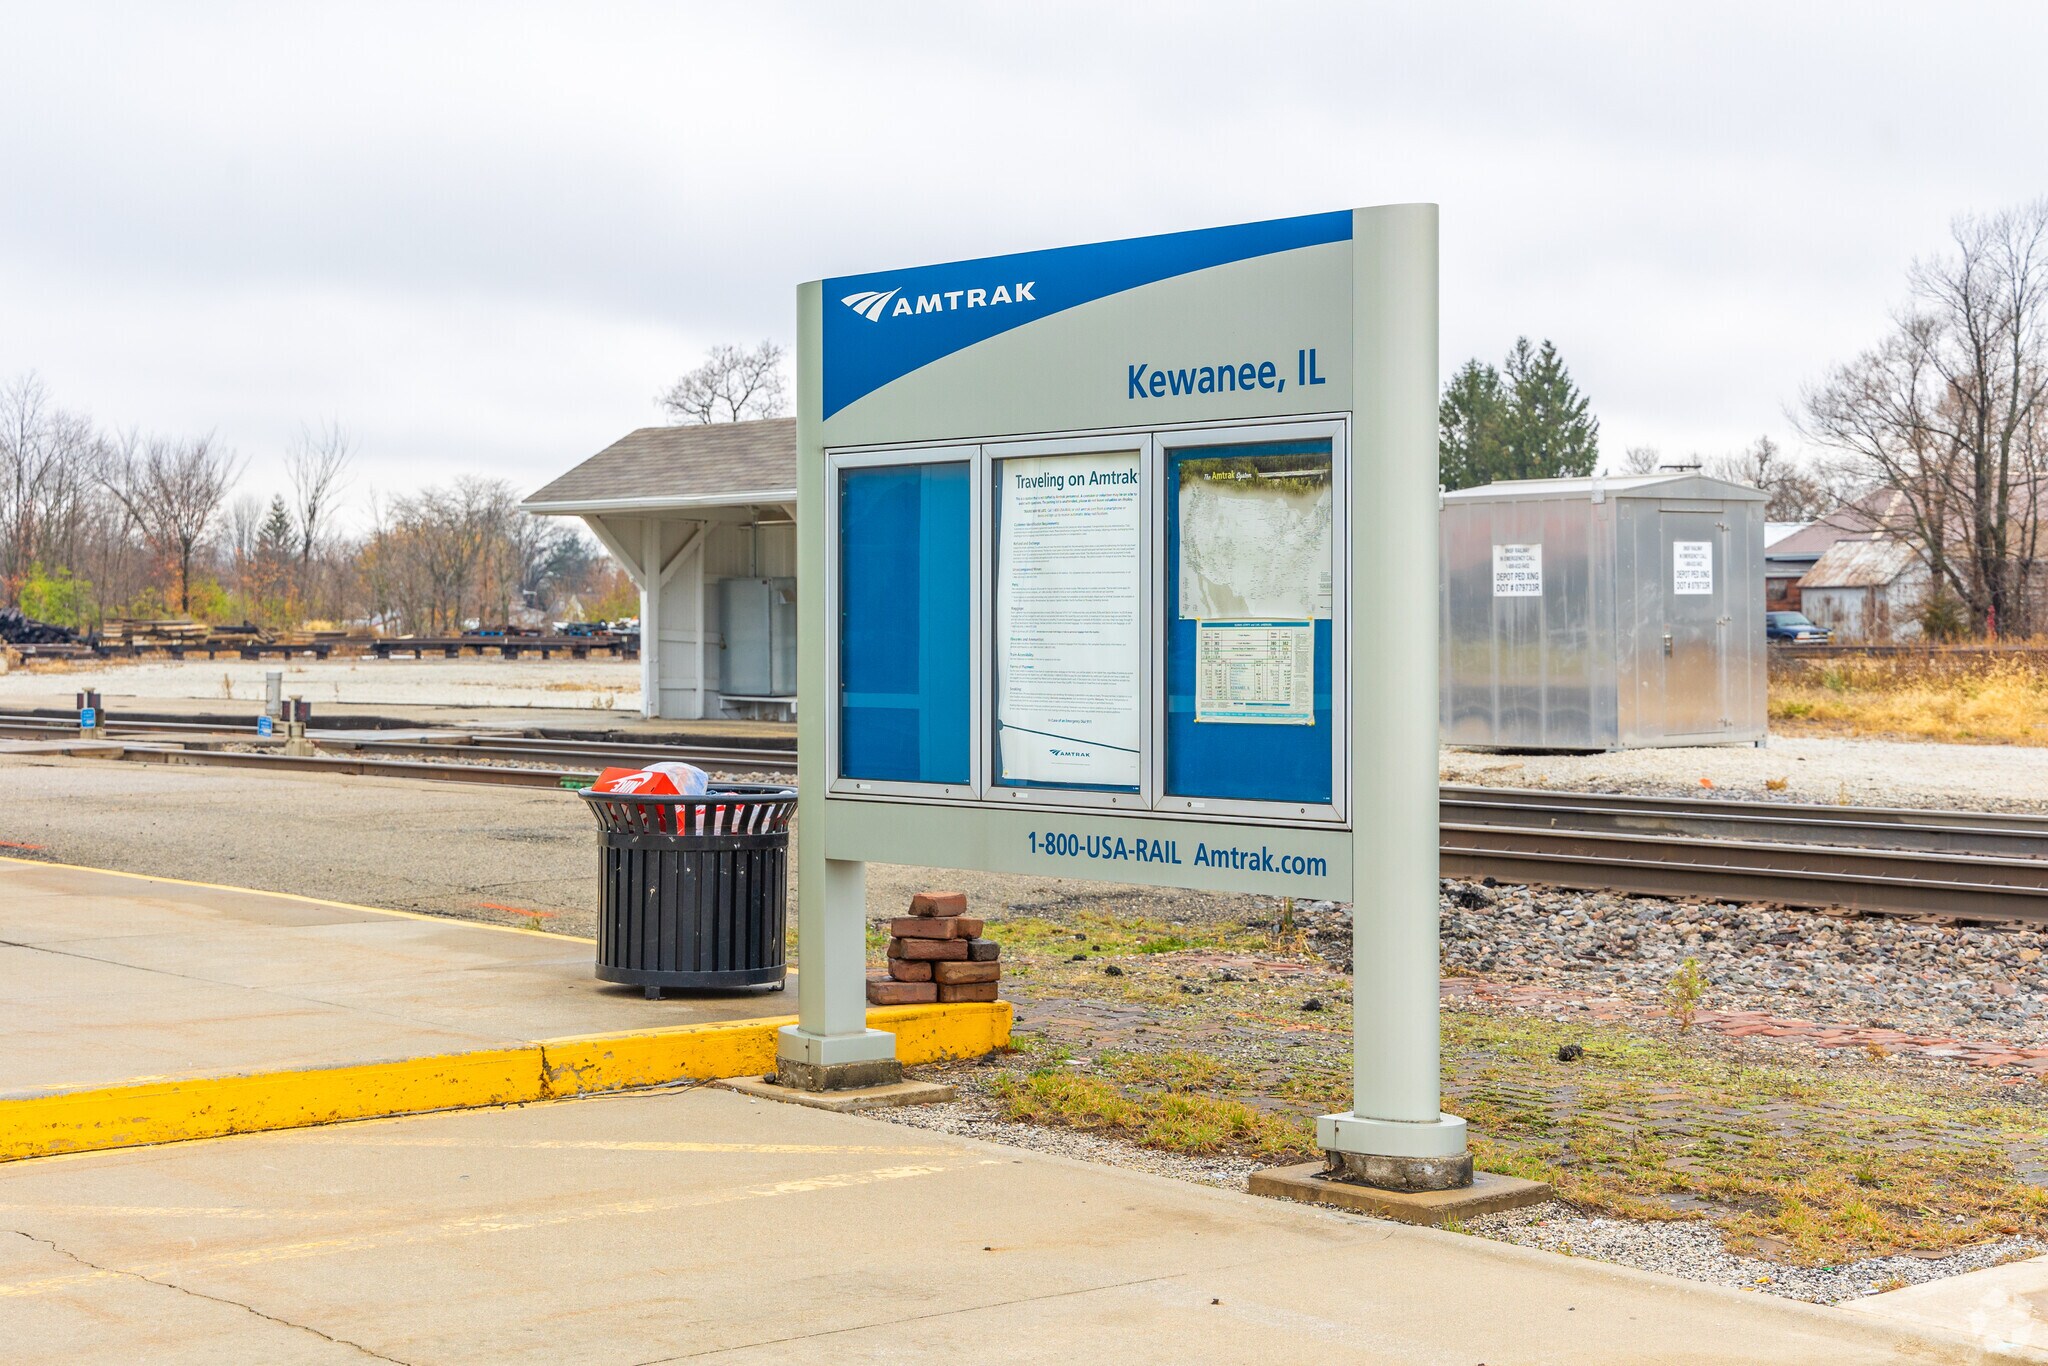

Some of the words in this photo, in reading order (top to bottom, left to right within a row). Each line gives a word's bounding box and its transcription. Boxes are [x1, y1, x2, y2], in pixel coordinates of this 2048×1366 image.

[892, 281, 1036, 317] AMTRAK
[1128, 361, 1286, 399] Kewanee,
[1298, 348, 1326, 386] IL
[1015, 472, 1064, 491] Traveling
[1068, 474, 1085, 486] on
[1089, 468, 1138, 485] Amtrak
[1211, 470, 1235, 480] Amtrak
[1496, 572, 1513, 581] DEPOT
[1515, 572, 1525, 580] PED
[1526, 572, 1539, 580] XING
[1676, 570, 1690, 578] DEPOT
[1496, 584, 1508, 592] DOT
[1676, 582, 1686, 590] DOT
[1028, 831, 1182, 865] 1-800-USA-RAIL
[1194, 843, 1327, 877] Amtrak.com
